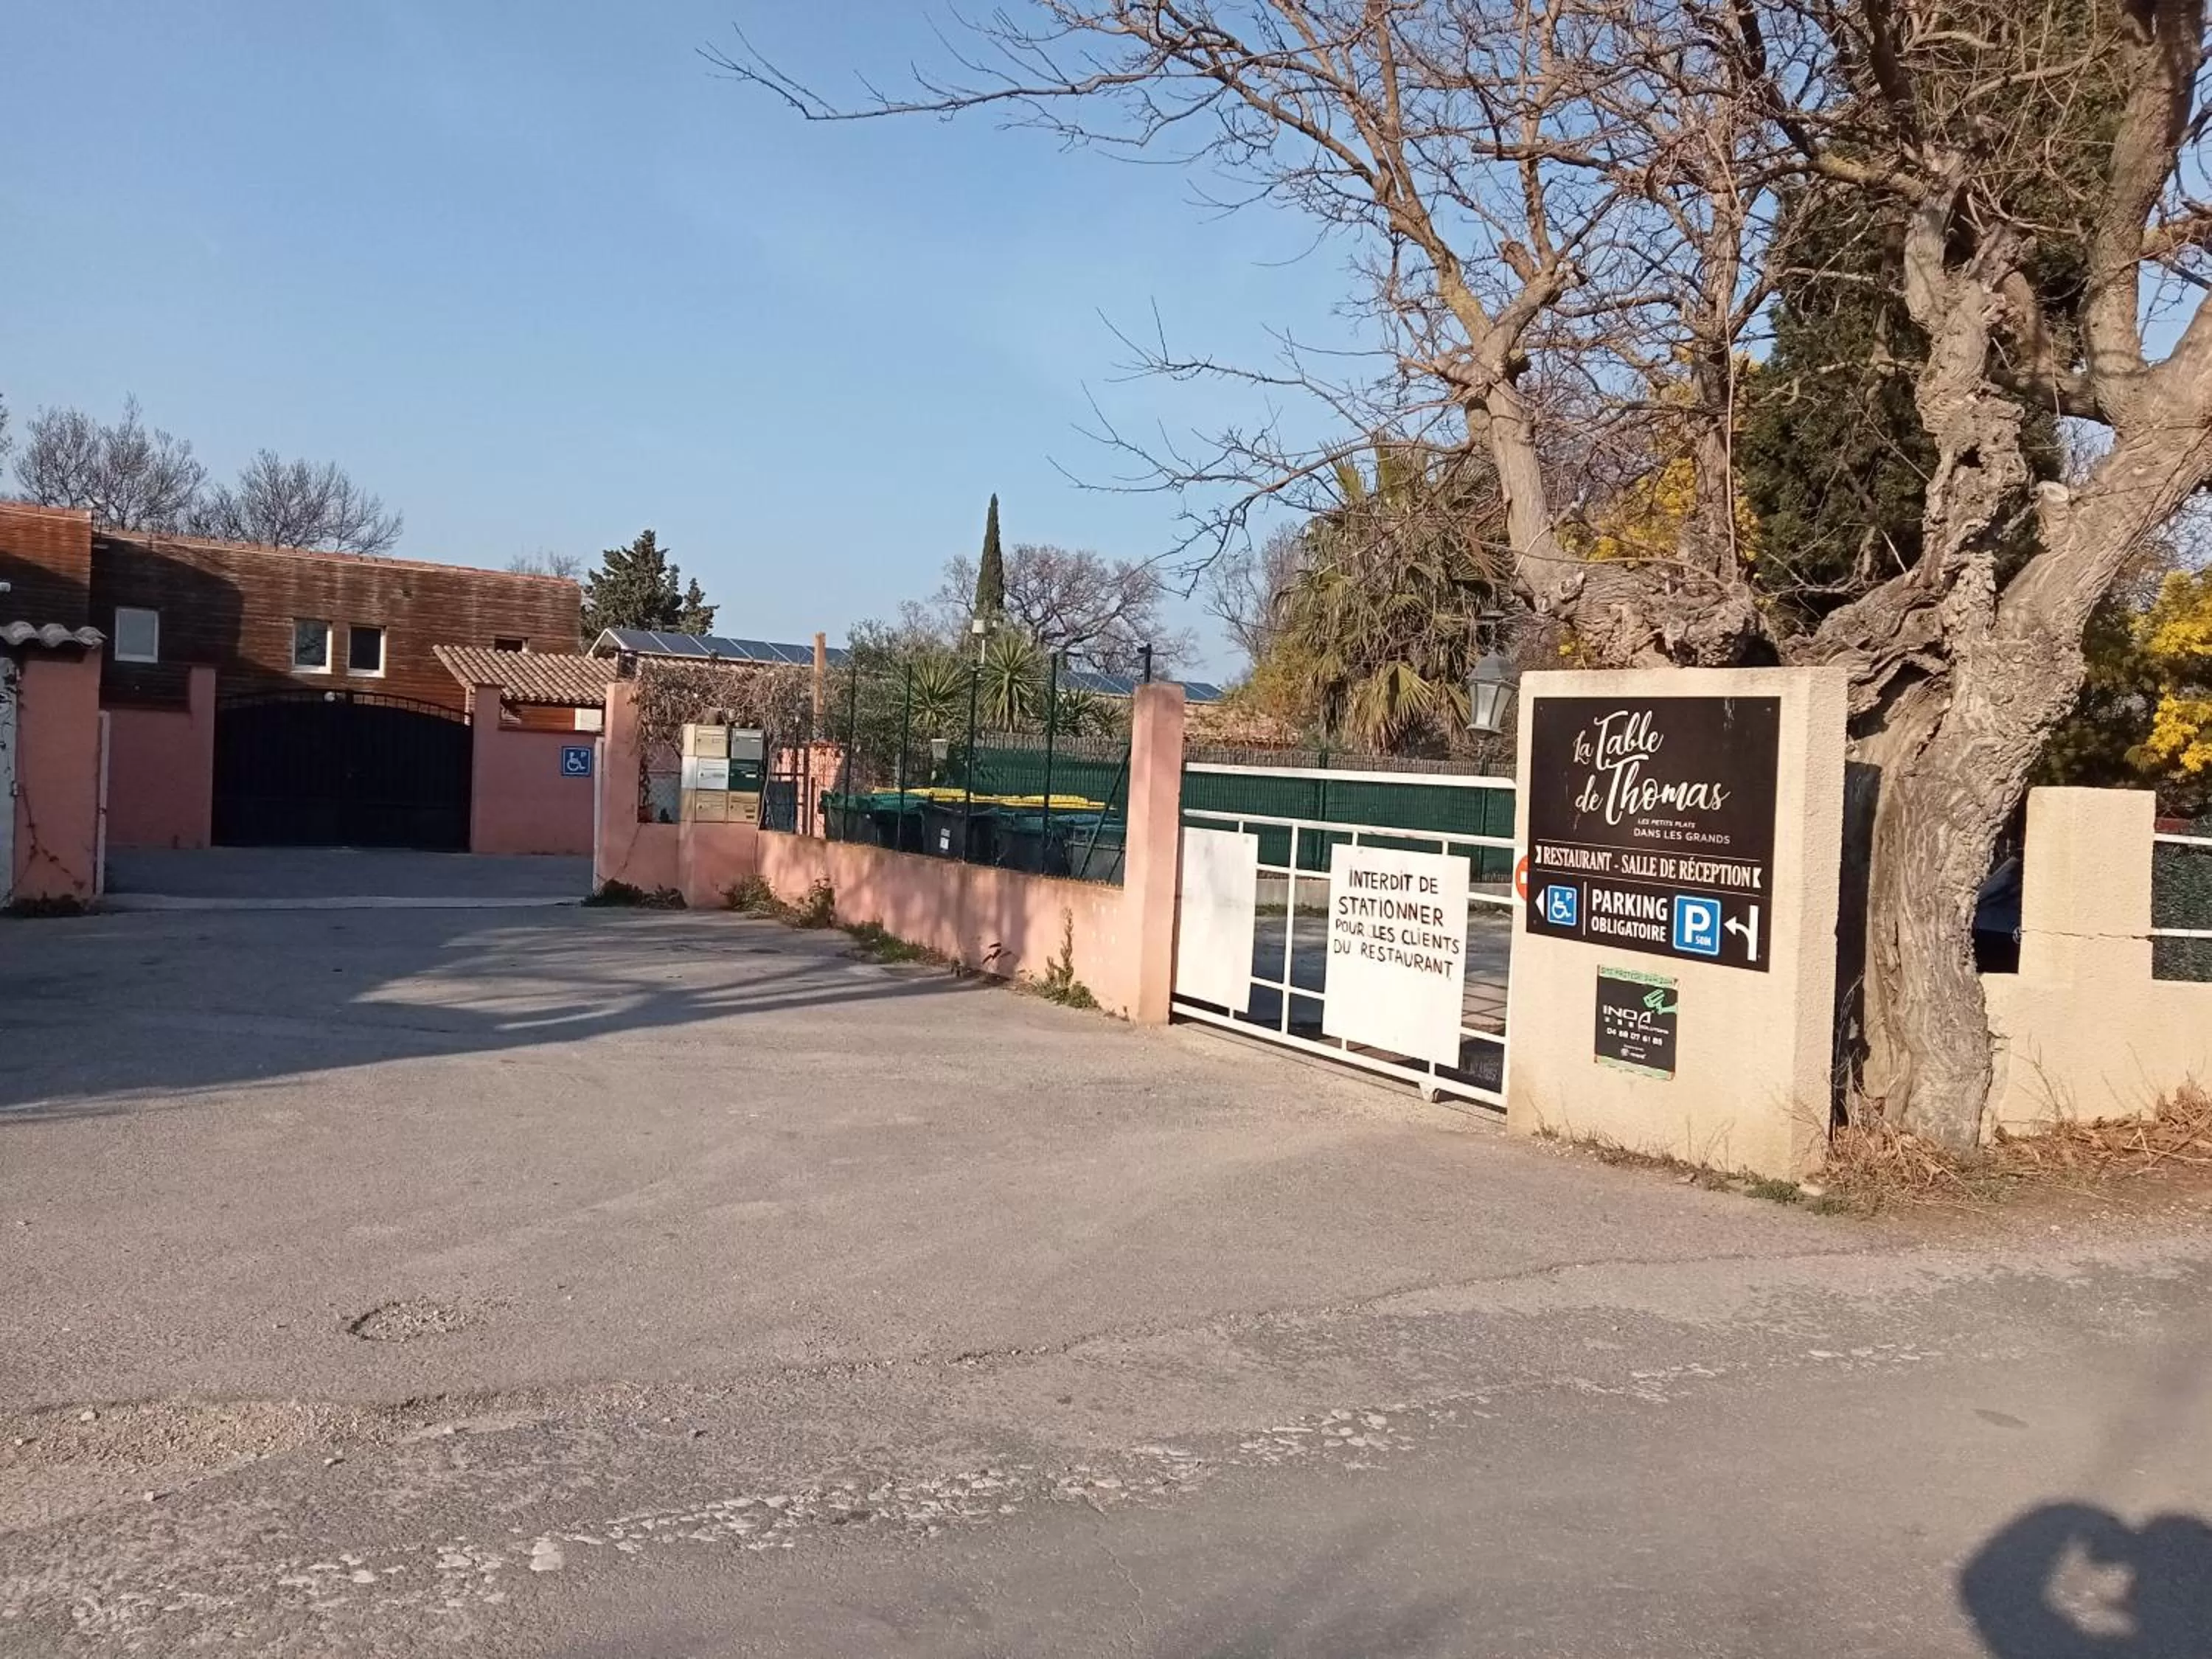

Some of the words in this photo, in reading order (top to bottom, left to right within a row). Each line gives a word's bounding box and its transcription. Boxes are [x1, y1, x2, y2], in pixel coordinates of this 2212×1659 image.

[1593, 710, 1664, 771] Table
[1575, 774, 1604, 813] de
[1605, 754, 1731, 825] Thomas
[1633, 827, 1661, 838] DANS
[1663, 830, 1683, 841] LES
[1685, 831, 1731, 844] GRANDS
[1543, 846, 1613, 872] RESTAURANT
[1621, 853, 1658, 877] SALLE
[1659, 858, 1677, 879] DE
[1678, 857, 1751, 887] RÉCEPTION
[1419, 875, 1439, 894] DE
[1565, 891, 1573, 902] P
[1338, 895, 1444, 928] STATIONNER
[1592, 888, 1668, 922] PARKING
[1335, 918, 1365, 937] POUR
[1371, 923, 1396, 944] LES
[1590, 916, 1667, 942] OBLIGATOIRE
[1684, 904, 1711, 943] P
[1333, 939, 1352, 955] DU
[1603, 1005, 1651, 1029] INOA
